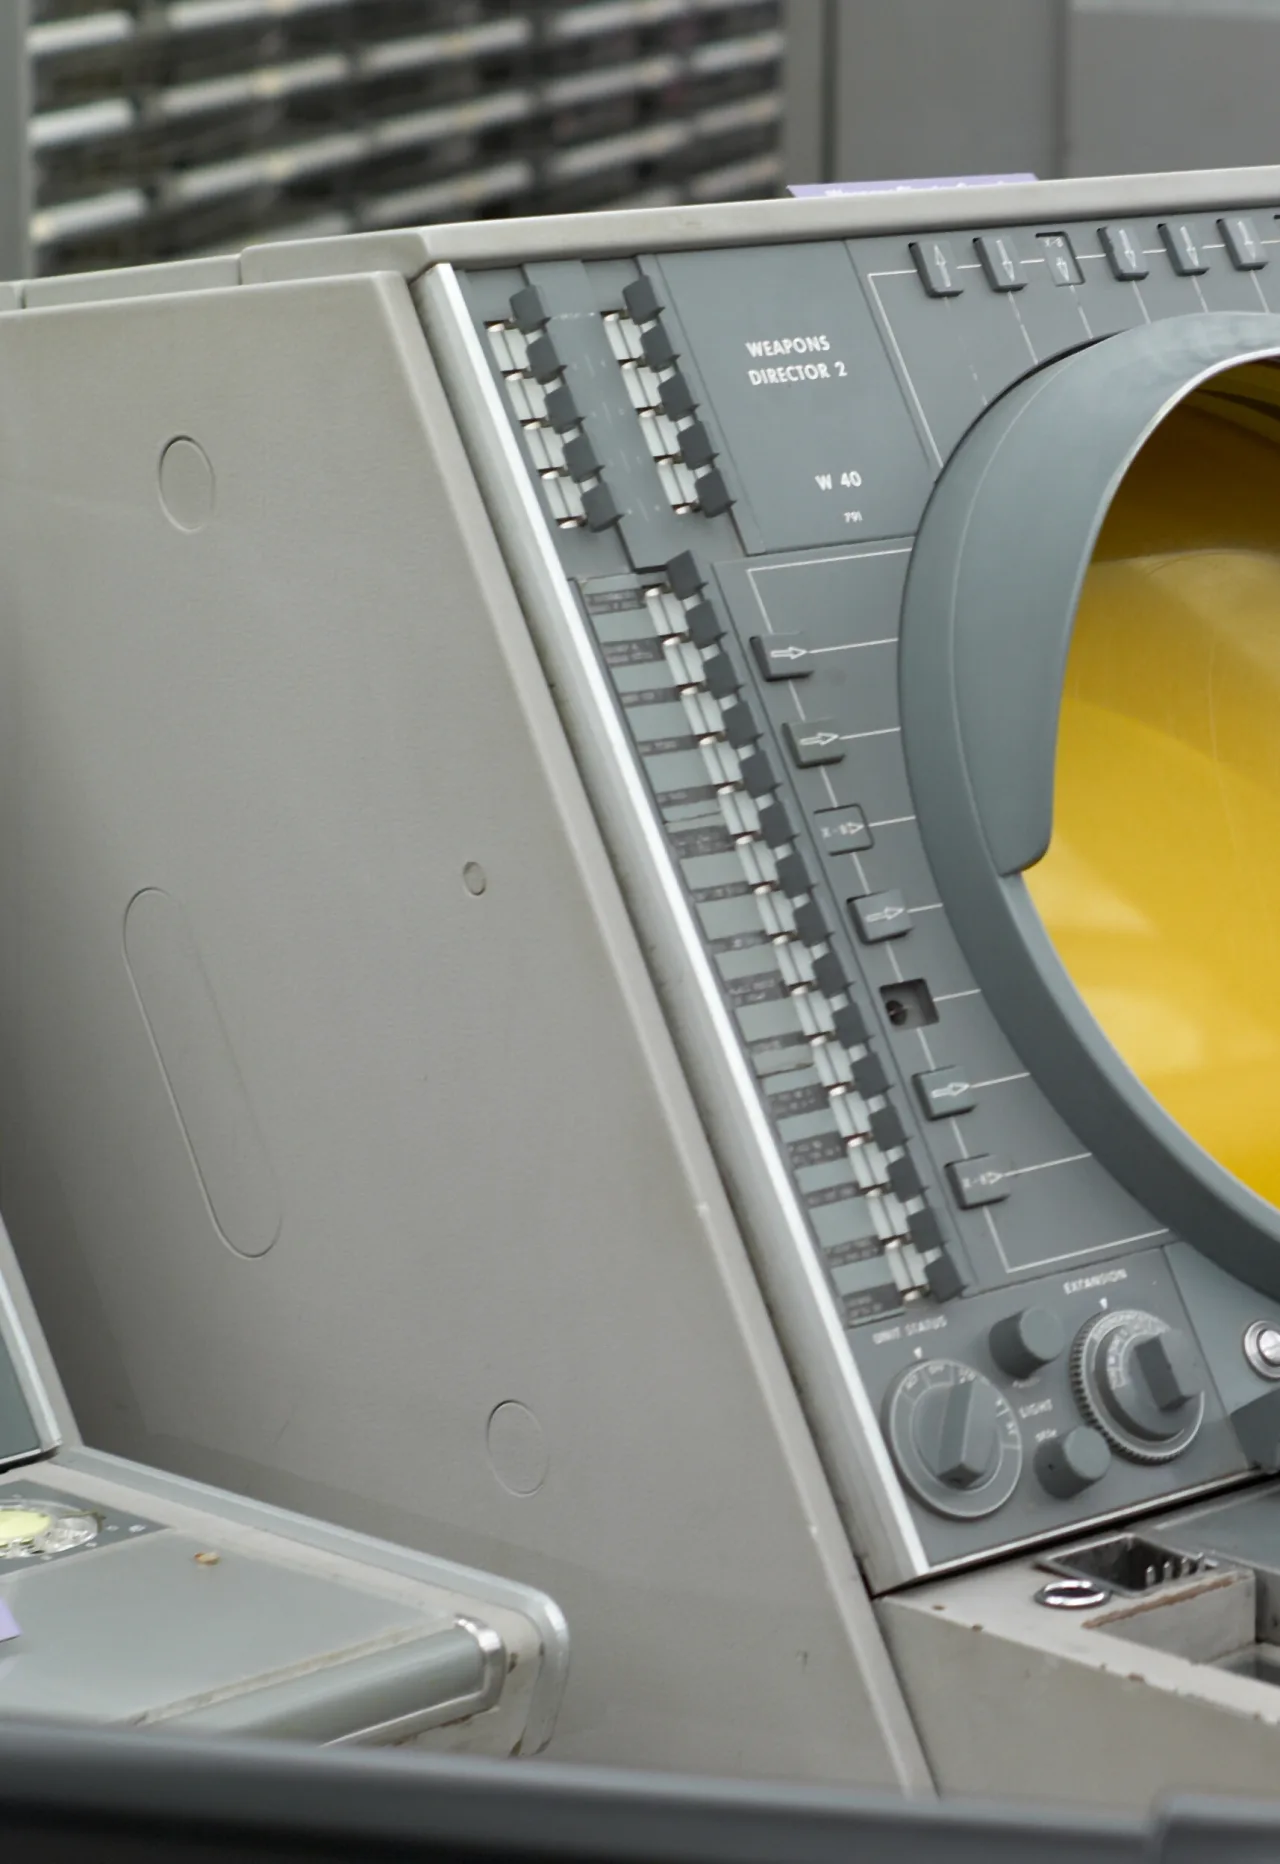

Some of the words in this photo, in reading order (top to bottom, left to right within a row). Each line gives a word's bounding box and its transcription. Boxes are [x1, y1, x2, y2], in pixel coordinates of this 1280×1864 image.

[745, 334, 831, 358] WEAPONS
[748, 362, 831, 386] DIRECTOR
[834, 361, 848, 377] 2
[814, 473, 833, 491] W
[840, 470, 862, 488] 40
[1063, 1268, 1128, 1295] EXPANSION
[1019, 1398, 1053, 1419] LIGHT
